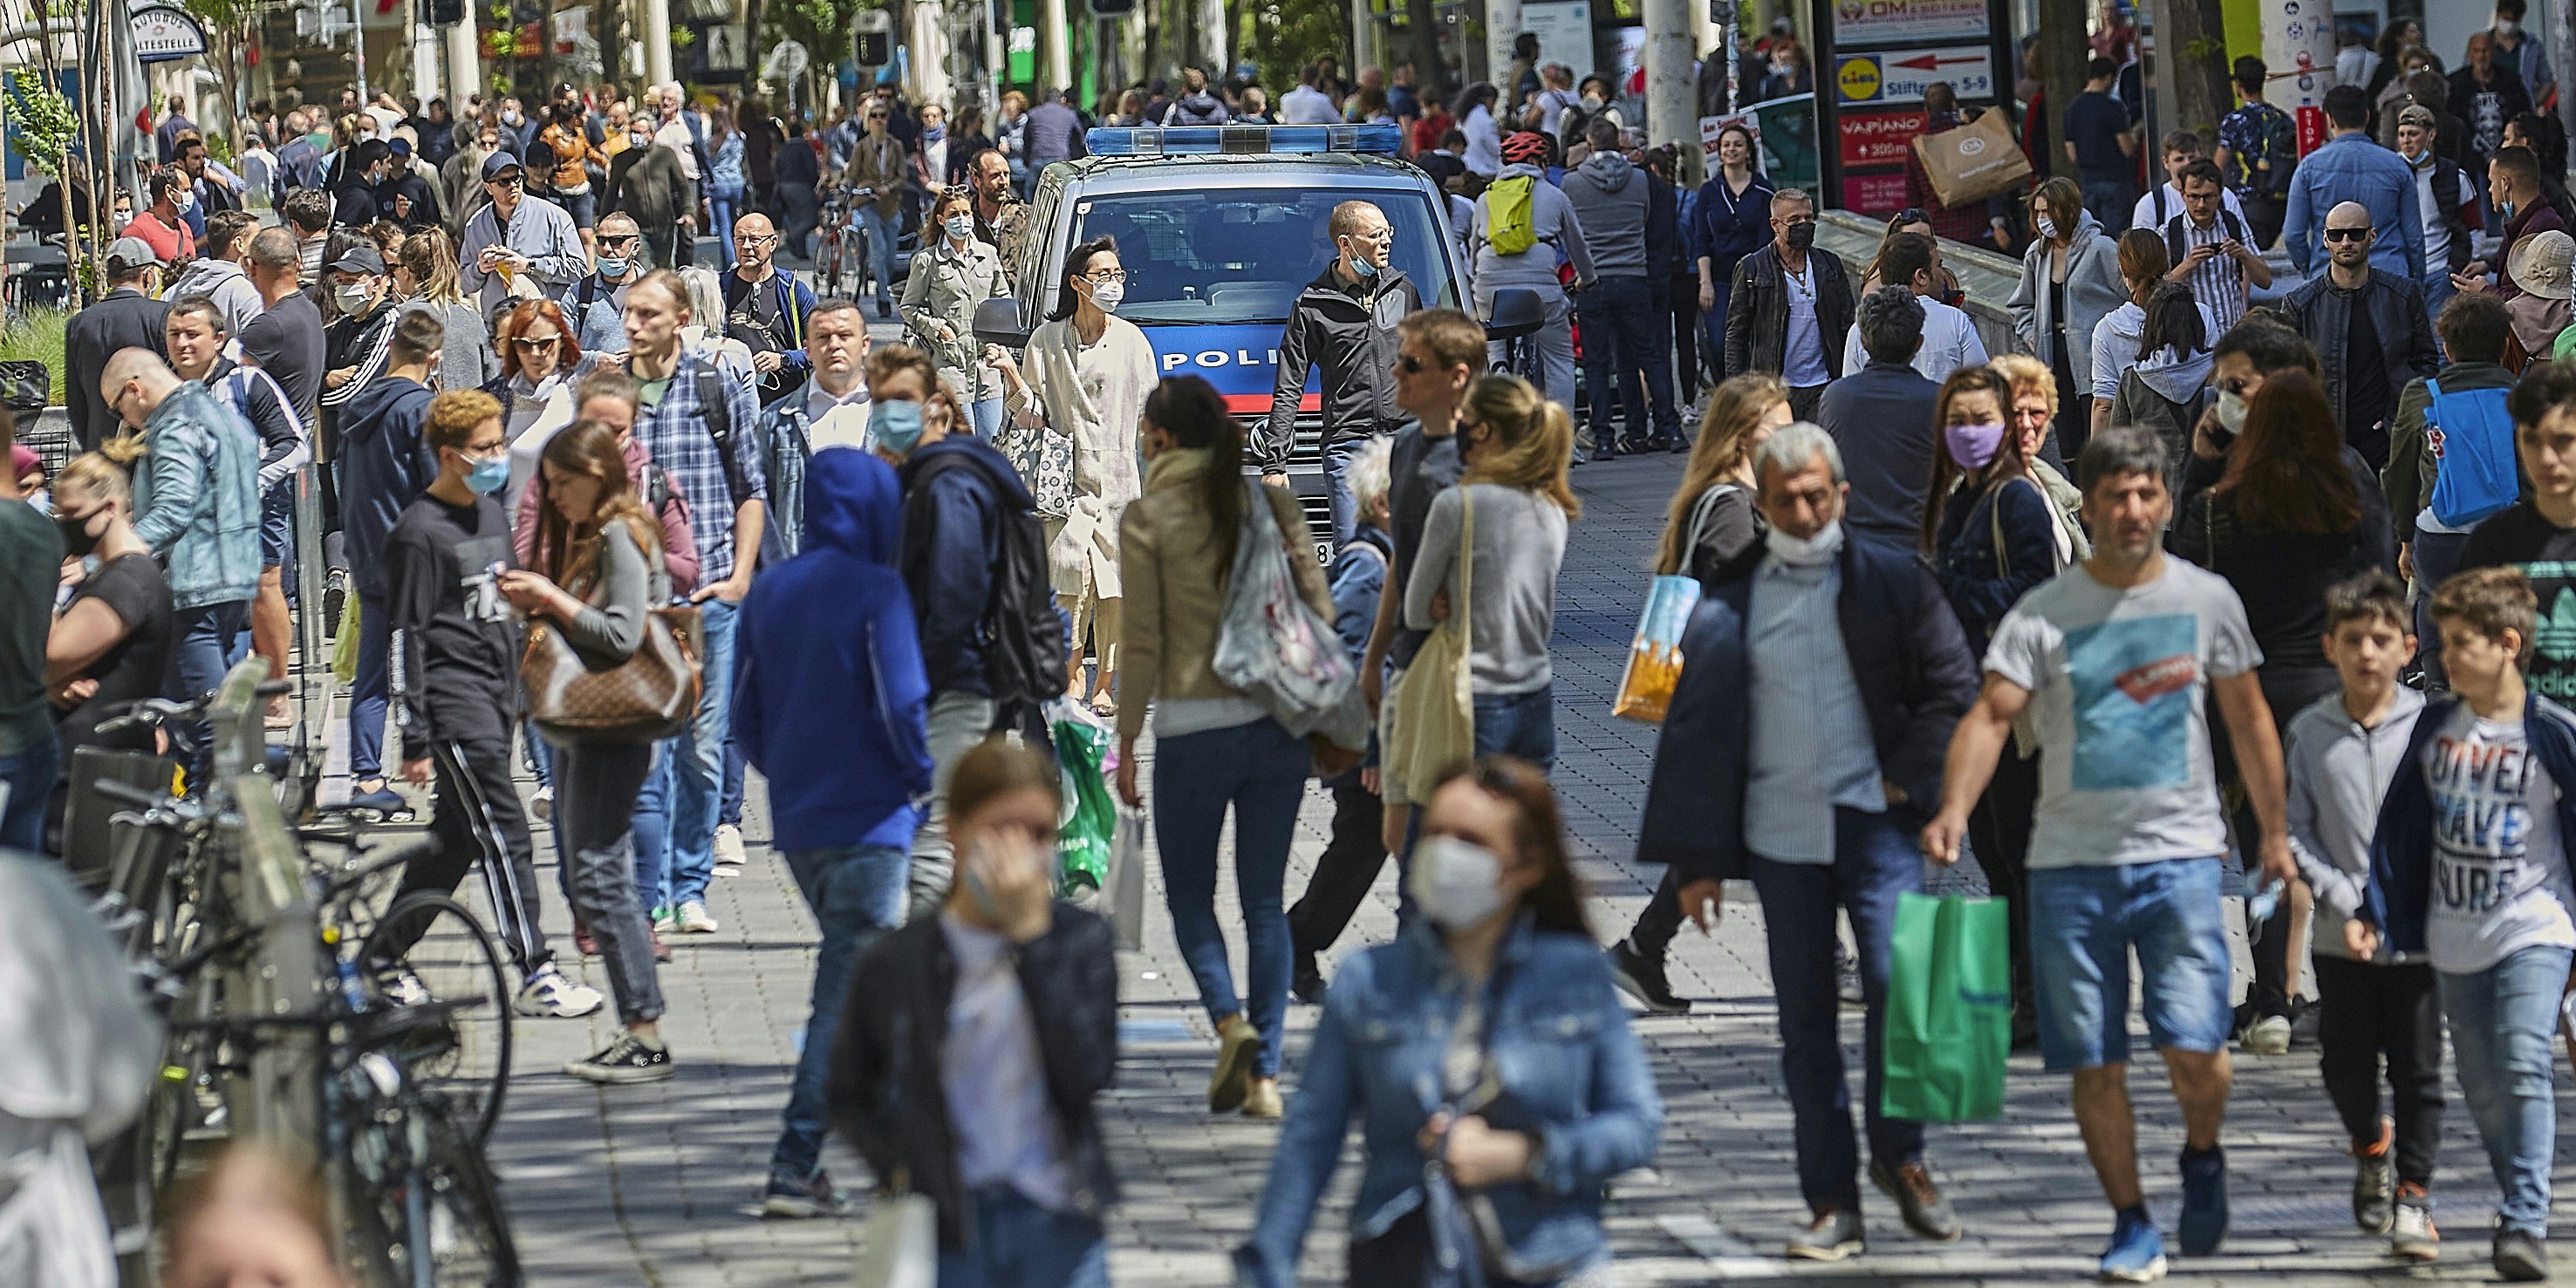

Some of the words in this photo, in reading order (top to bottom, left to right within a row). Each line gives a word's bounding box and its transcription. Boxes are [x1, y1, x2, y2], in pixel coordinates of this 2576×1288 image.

[134, 12, 185, 31] AUTOBUS
[1887, 80, 1958, 96] Stiftge
[1963, 76, 1988, 91] 5-9
[2305, 109, 2315, 145] STOP
[1317, 545, 1328, 563] 8
